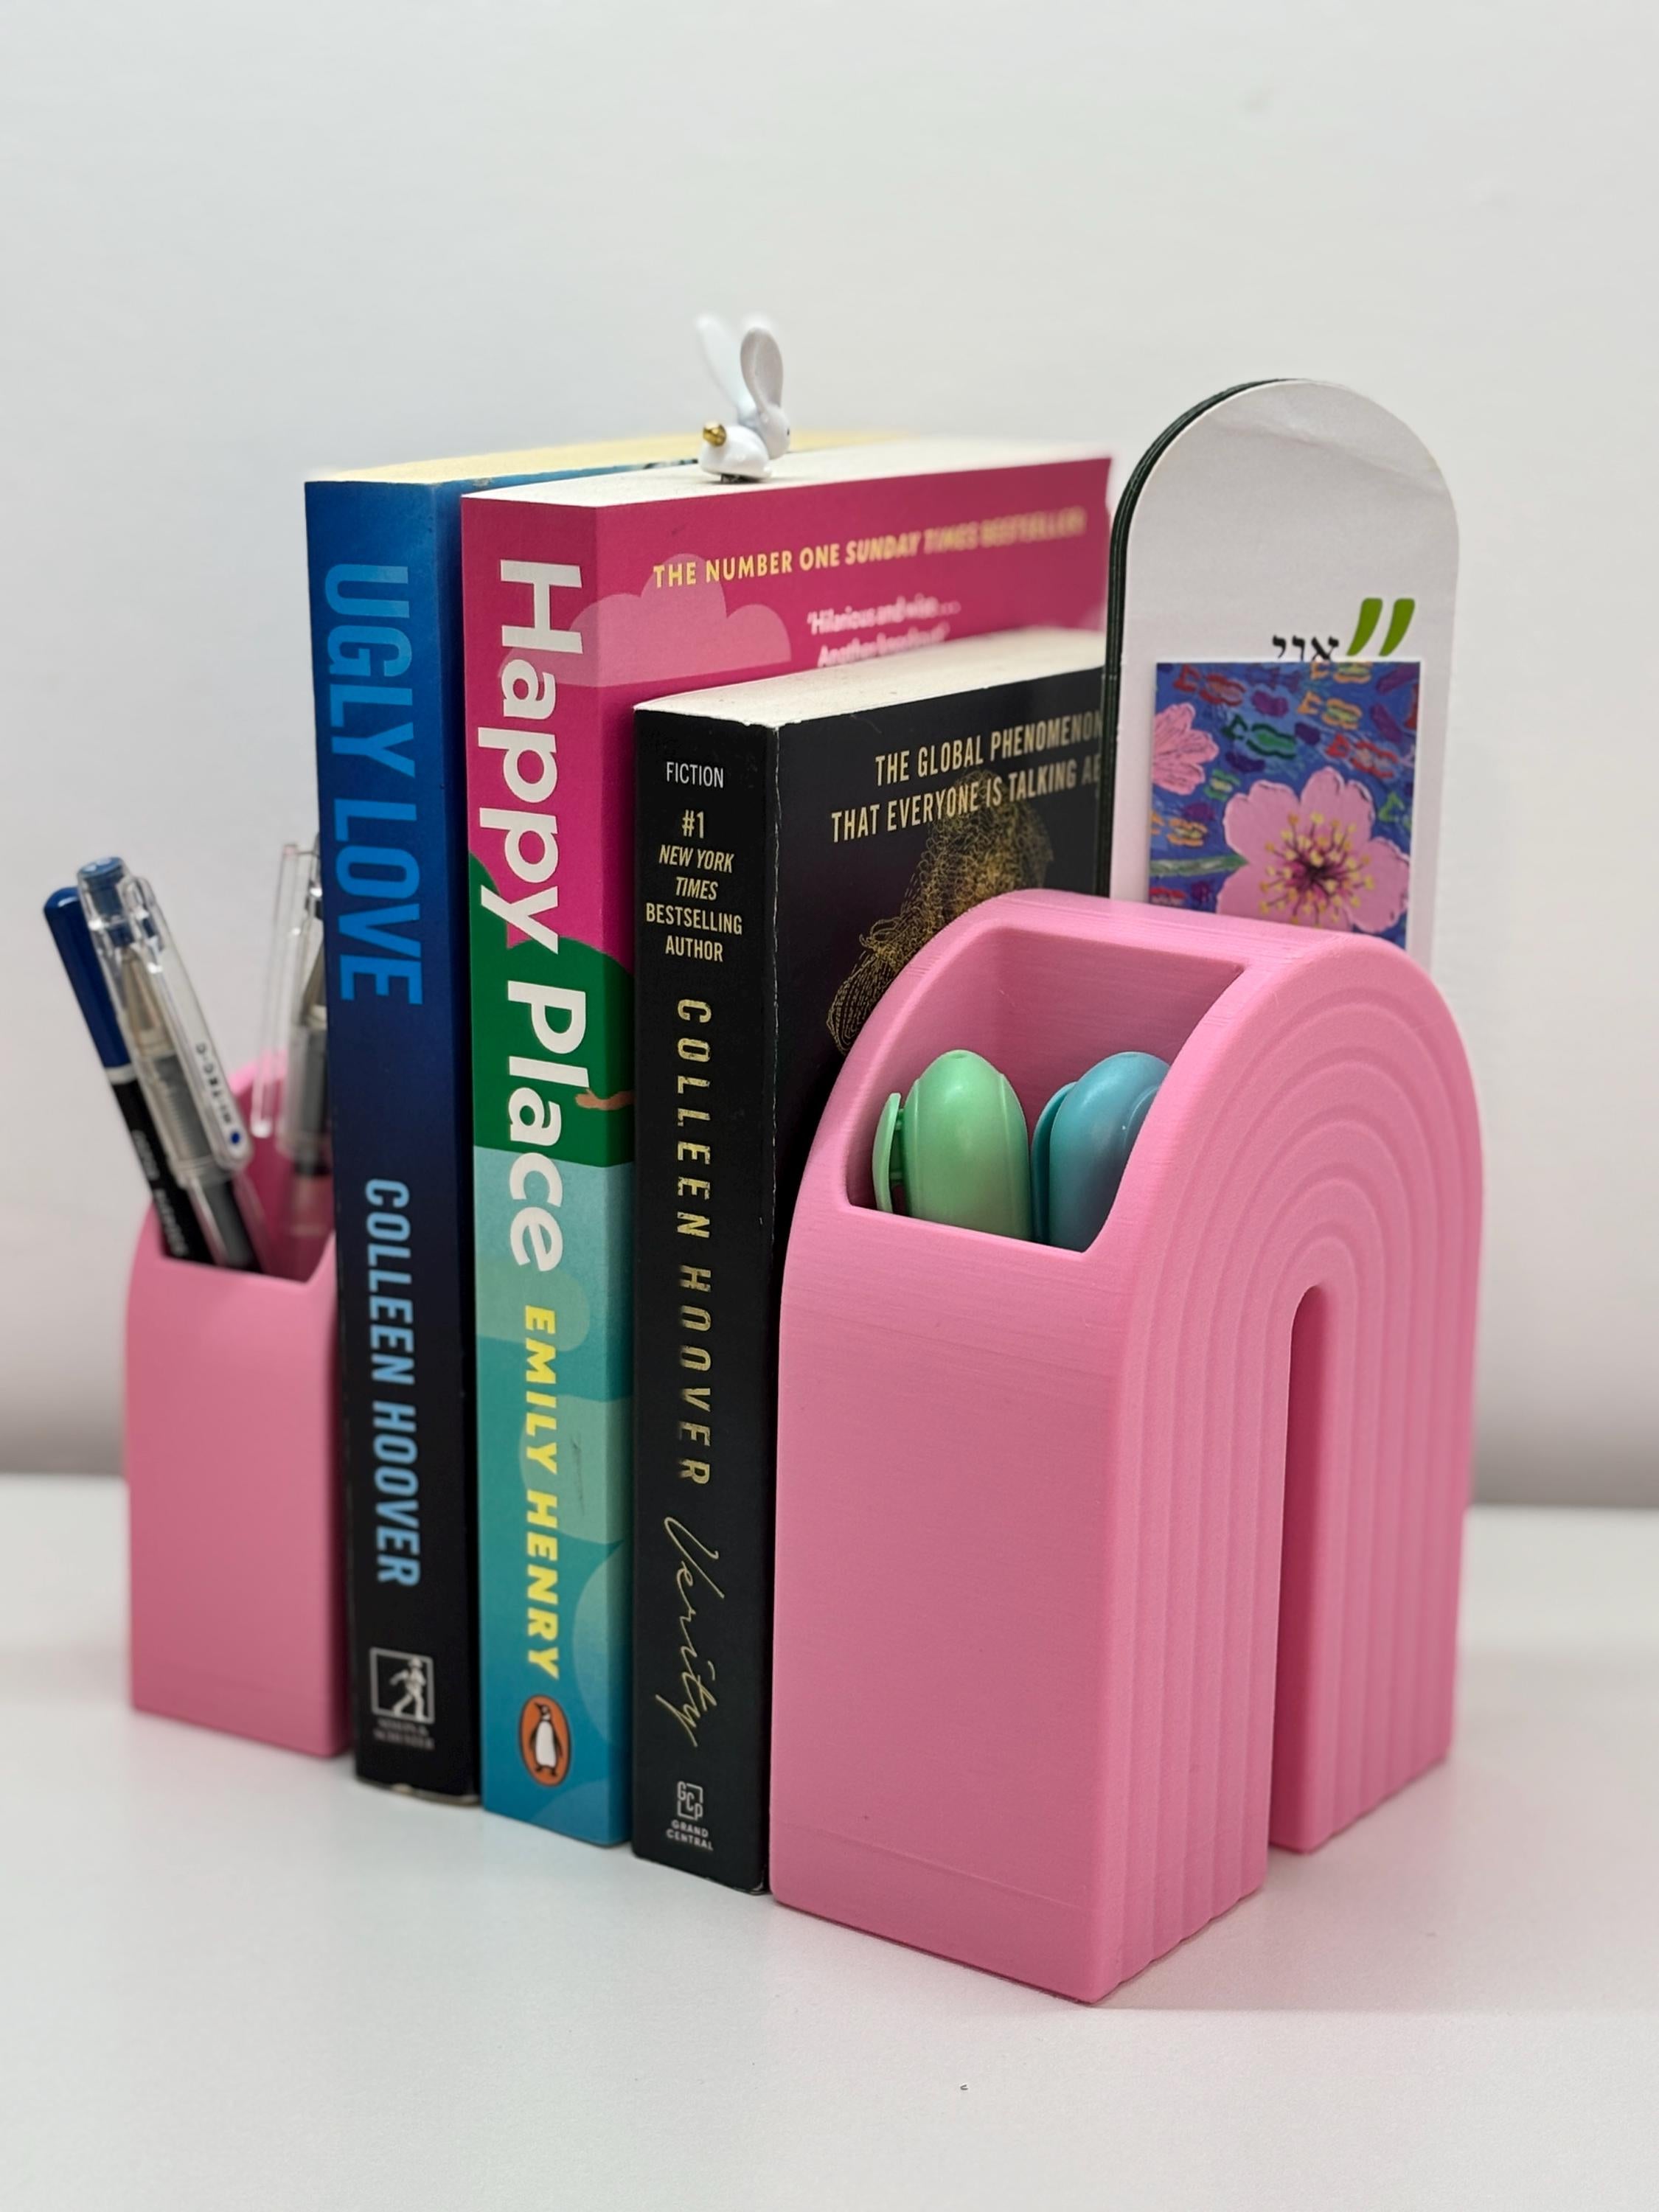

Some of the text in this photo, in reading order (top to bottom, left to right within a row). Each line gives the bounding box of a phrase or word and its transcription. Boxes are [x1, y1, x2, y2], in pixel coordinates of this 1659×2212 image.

[653, 561, 697, 588] THE
[705, 550, 793, 584] NUMBER
[799, 543, 841, 571] ONE
[844, 530, 922, 566] SUNDAY
[325, 563, 423, 1005] UGLY LOVE
[666, 761, 724, 789] FICTION
[875, 749, 911, 787] THE
[917, 734, 984, 778] GLOBAL
[681, 809, 705, 839] #1
[831, 804, 881, 844] THAT
[886, 780, 981, 832] EVERYONE
[985, 775, 1004, 808] IS
[1008, 758, 1078, 803] TALKING
[658, 844, 735, 874] NEW YORK
[675, 876, 720, 901] TIMES
[478, 559, 590, 1272] Happy Place
[646, 902, 743, 936] BESTSELLING
[665, 934, 724, 962] AUTHOR
[677, 998, 712, 1485] COLLEEN HOOVER
[365, 1179, 422, 1587] COLLEEN HOOVER
[524, 1304, 560, 1680] EMILY HENRY
[655, 1516, 725, 1748] Verity
[666, 1828, 714, 1851] CENTRAL
[671, 1819, 709, 1838] GRAND
